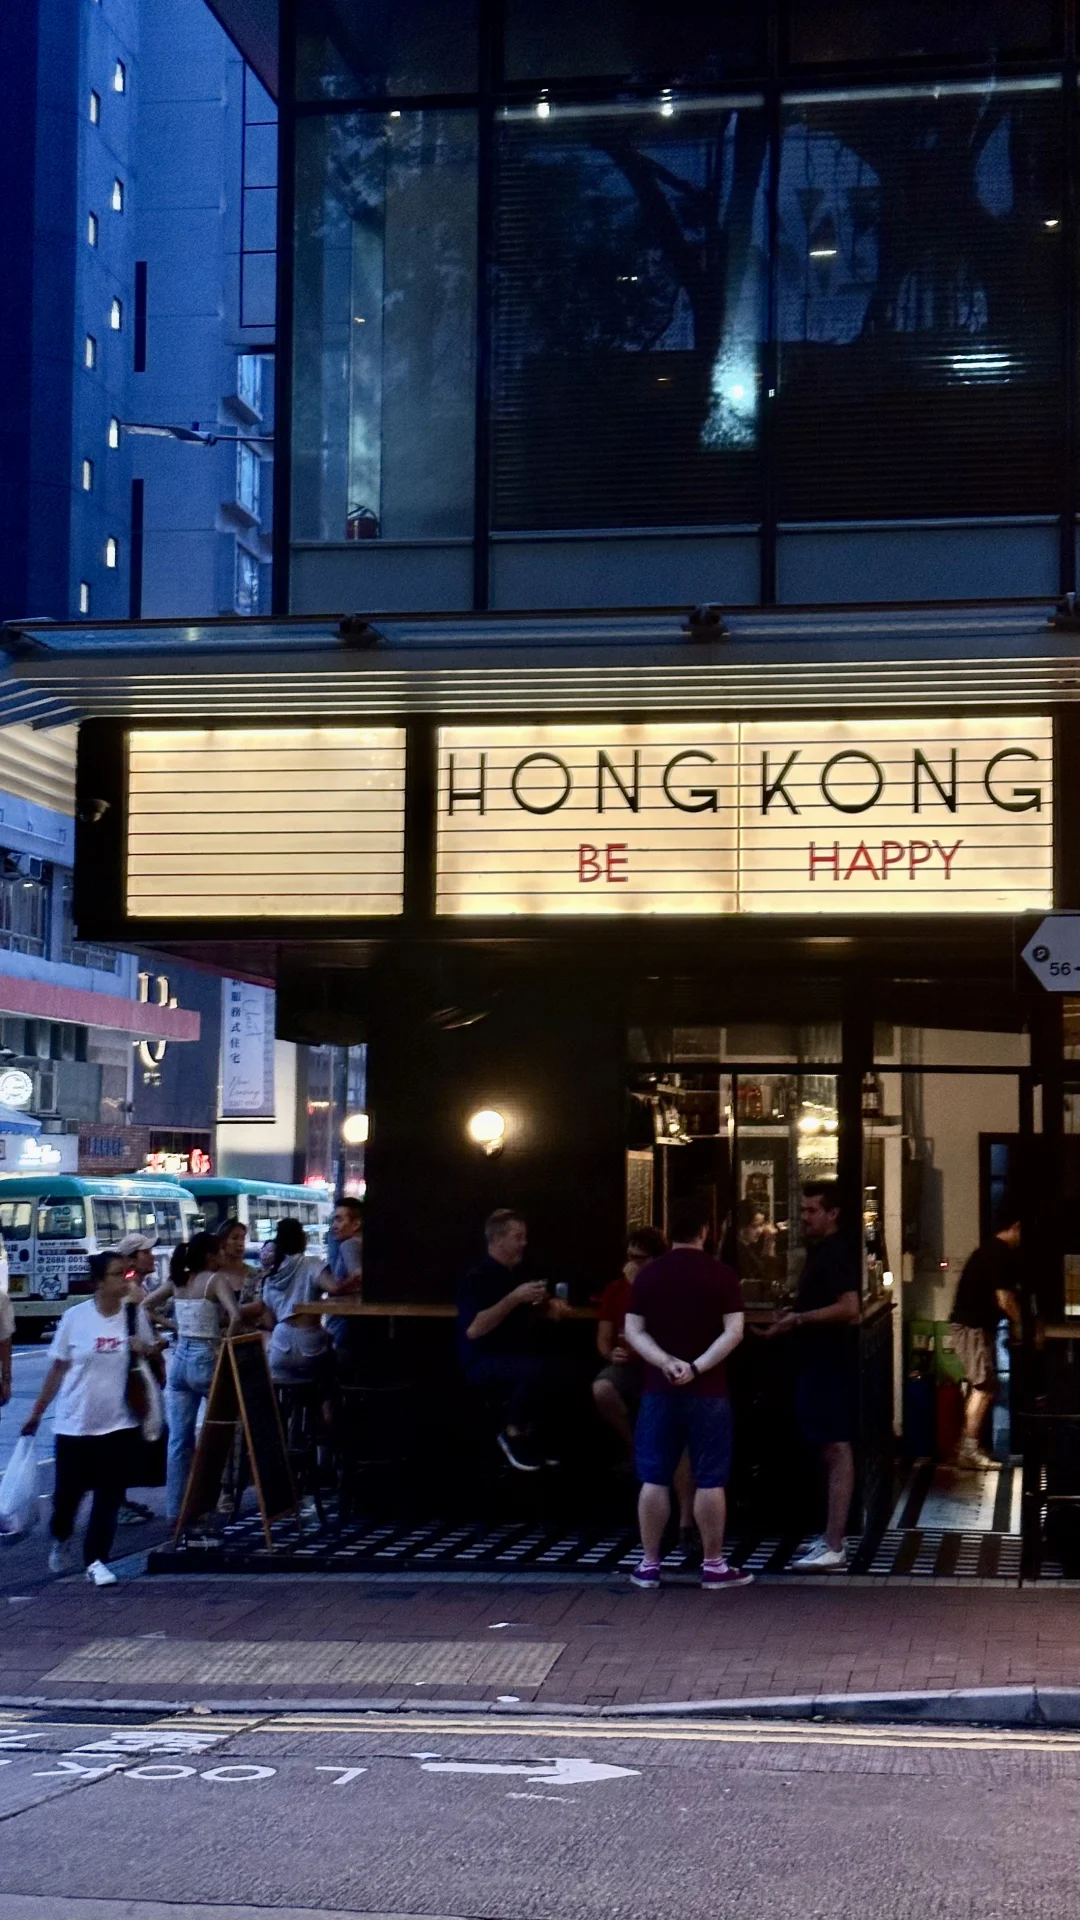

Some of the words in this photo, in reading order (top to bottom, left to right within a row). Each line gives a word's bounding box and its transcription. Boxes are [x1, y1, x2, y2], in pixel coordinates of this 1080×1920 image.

[447, 748, 719, 816] HONG
[761, 747, 1043, 815] KONG
[578, 843, 629, 884] BE
[808, 839, 965, 882] HAPPY
[1049, 962, 1071, 976] 56
[33, 1760, 368, 1785] LOOK
